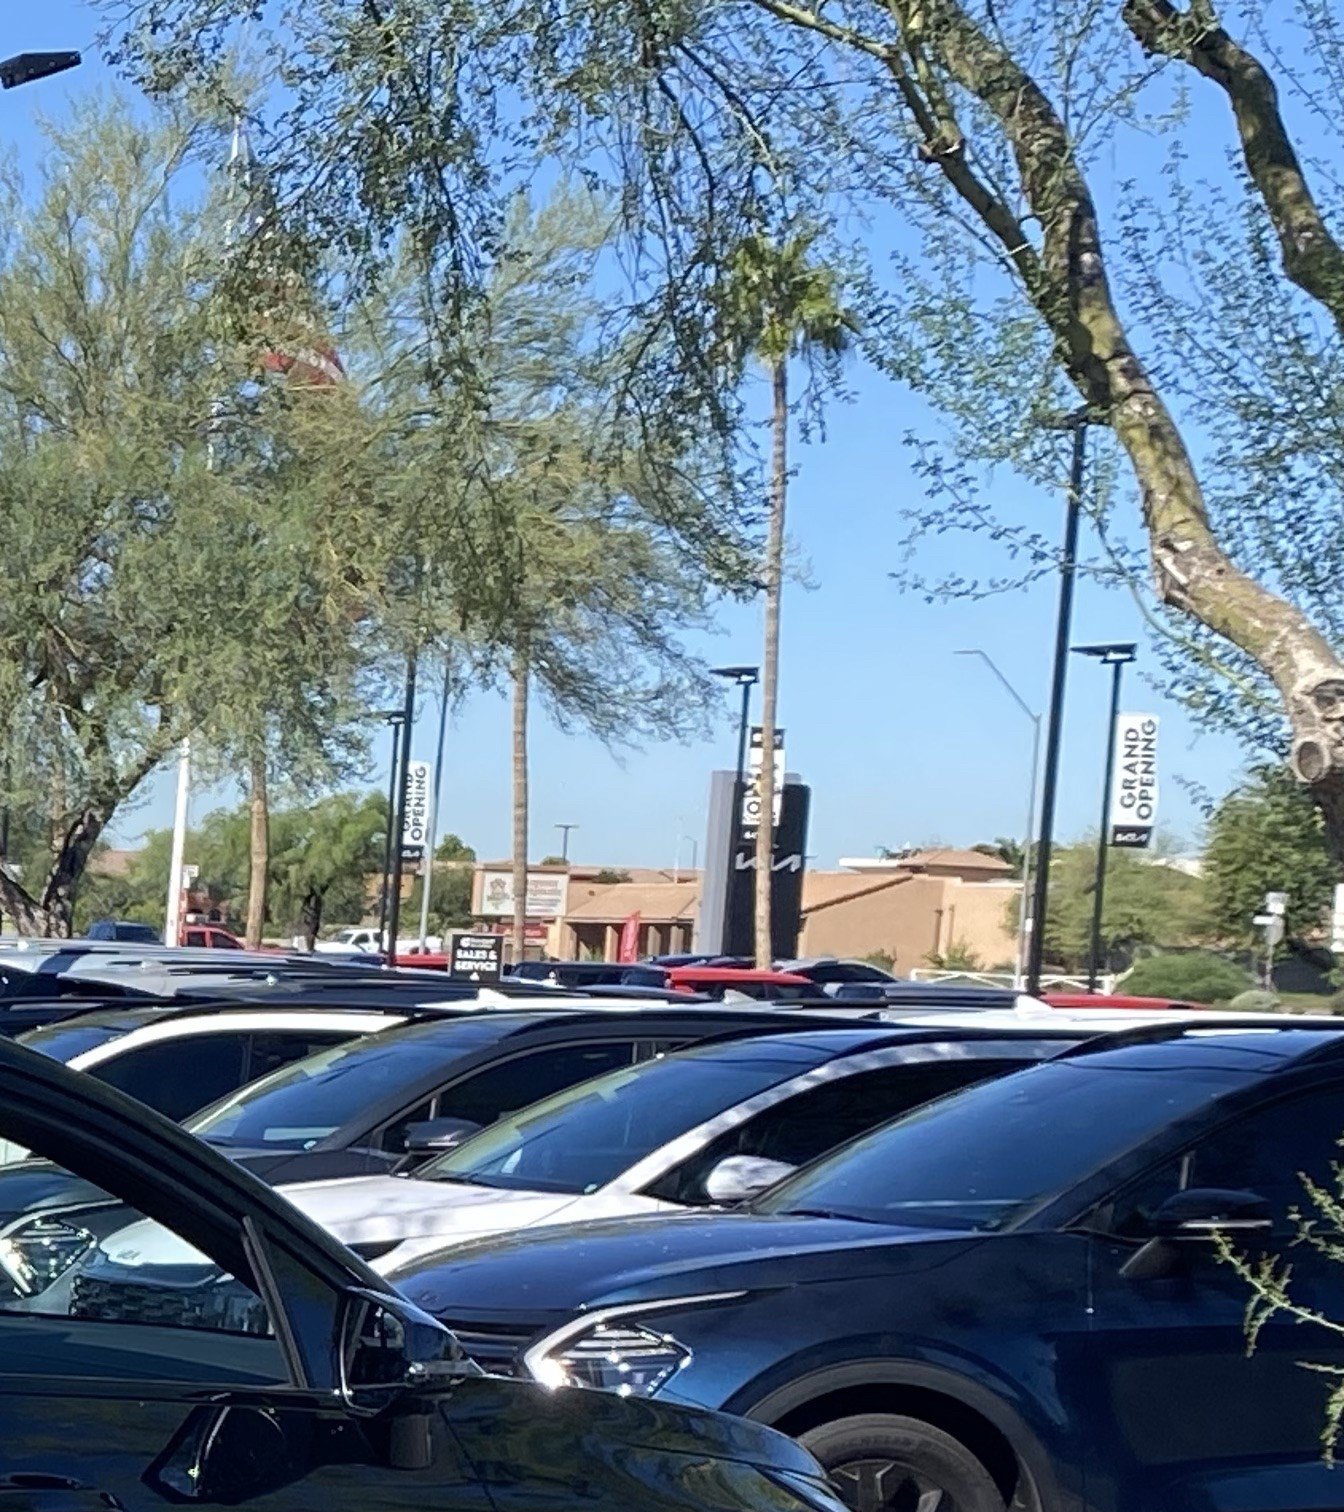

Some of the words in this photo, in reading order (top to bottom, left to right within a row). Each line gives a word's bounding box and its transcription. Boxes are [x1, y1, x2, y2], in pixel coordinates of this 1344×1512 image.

[410, 766, 427, 841] OPENING
[1120, 728, 1139, 809] GRAND
[1136, 719, 1157, 820] OPENING
[454, 960, 498, 972] SERVICE
[456, 949, 488, 960] SALES
[488, 950, 498, 960] &
